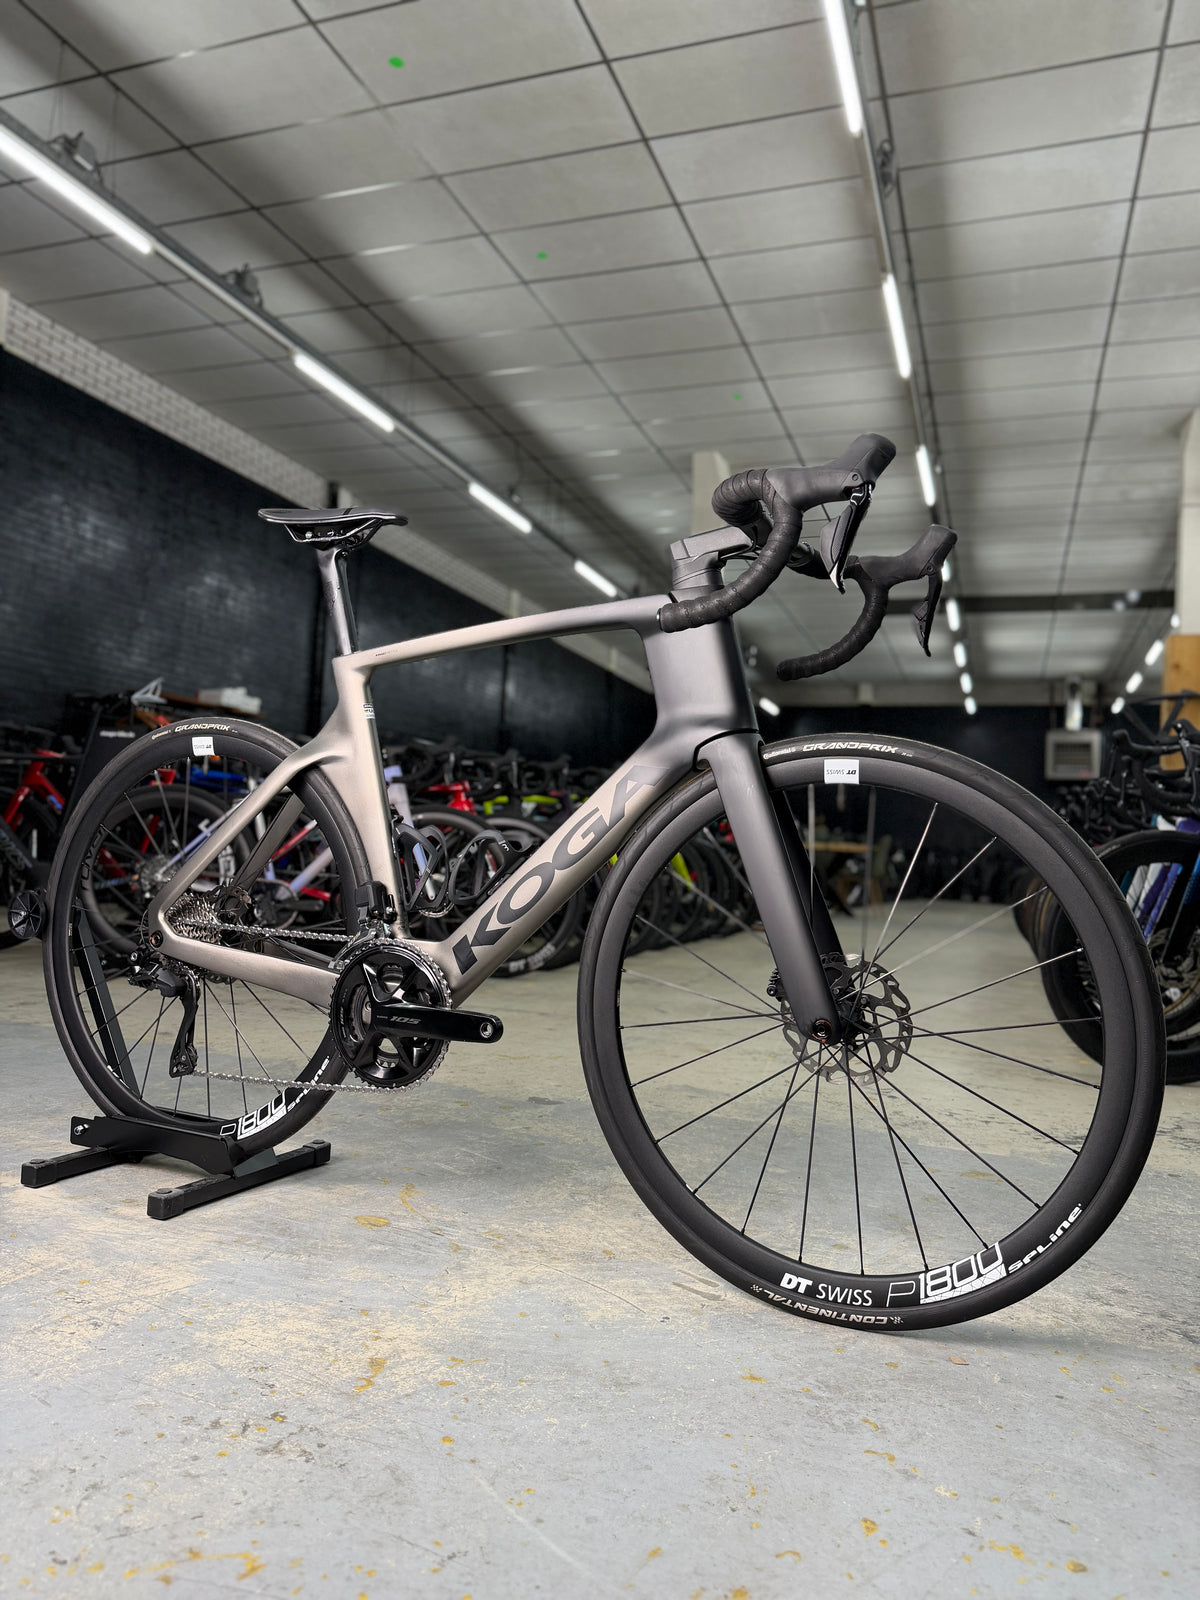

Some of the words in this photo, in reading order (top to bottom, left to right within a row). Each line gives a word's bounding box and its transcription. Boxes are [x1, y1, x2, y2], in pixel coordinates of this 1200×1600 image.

[174, 723, 231, 733] GRANDPRIX
[802, 741, 899, 754] GRANDPRIX
[451, 764, 670, 976] KOGA
[390, 1016, 422, 1025] 105
[780, 1272, 813, 1294] DT
[816, 1283, 873, 1306] SWISS
[763, 1290, 888, 1325] CONTINENTAL
